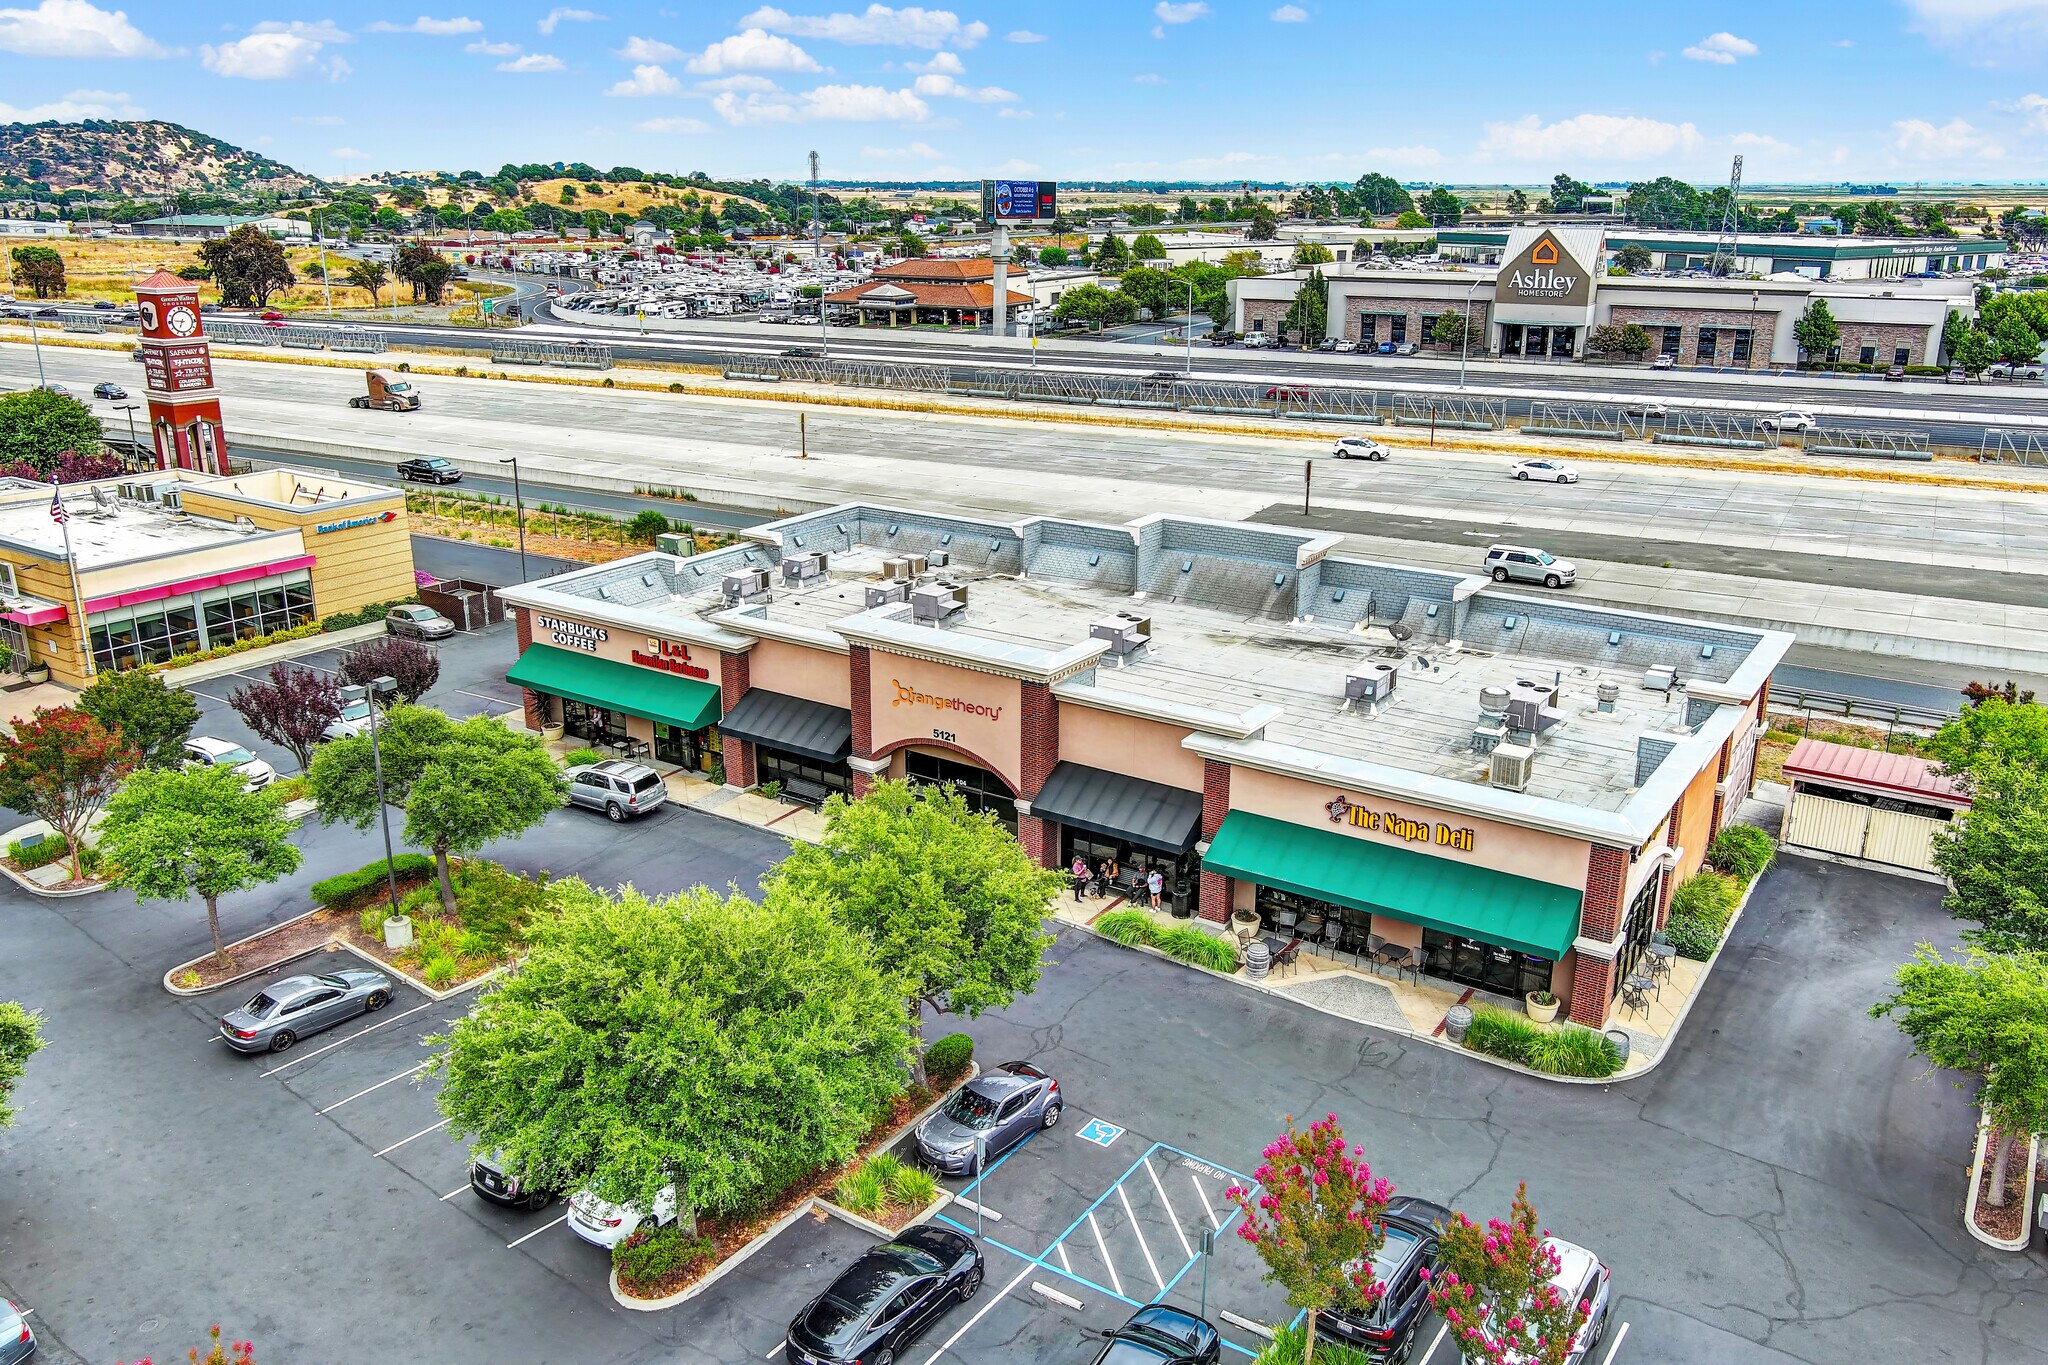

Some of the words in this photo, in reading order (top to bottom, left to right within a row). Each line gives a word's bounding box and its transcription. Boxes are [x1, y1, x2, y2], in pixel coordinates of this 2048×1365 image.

[1508, 268, 1578, 295] Ashley
[1518, 289, 1564, 298] HOMESTORE
[170, 348, 198, 356] SAFEWAY
[317, 523, 338, 534] Bank
[347, 516, 378, 528] America
[538, 615, 608, 642] STARBUCKS
[552, 632, 596, 652] COFFEE
[662, 640, 691, 661] L&L
[631, 649, 669, 671] Hawaiian
[669, 659, 709, 680] Barbecue
[933, 728, 956, 743] 5121
[1349, 803, 1380, 831] The
[1383, 812, 1430, 842] Napa
[1435, 823, 1474, 851] Deli
[1182, 1158, 1215, 1176] PARKING
[1213, 1171, 1228, 1180] NO
